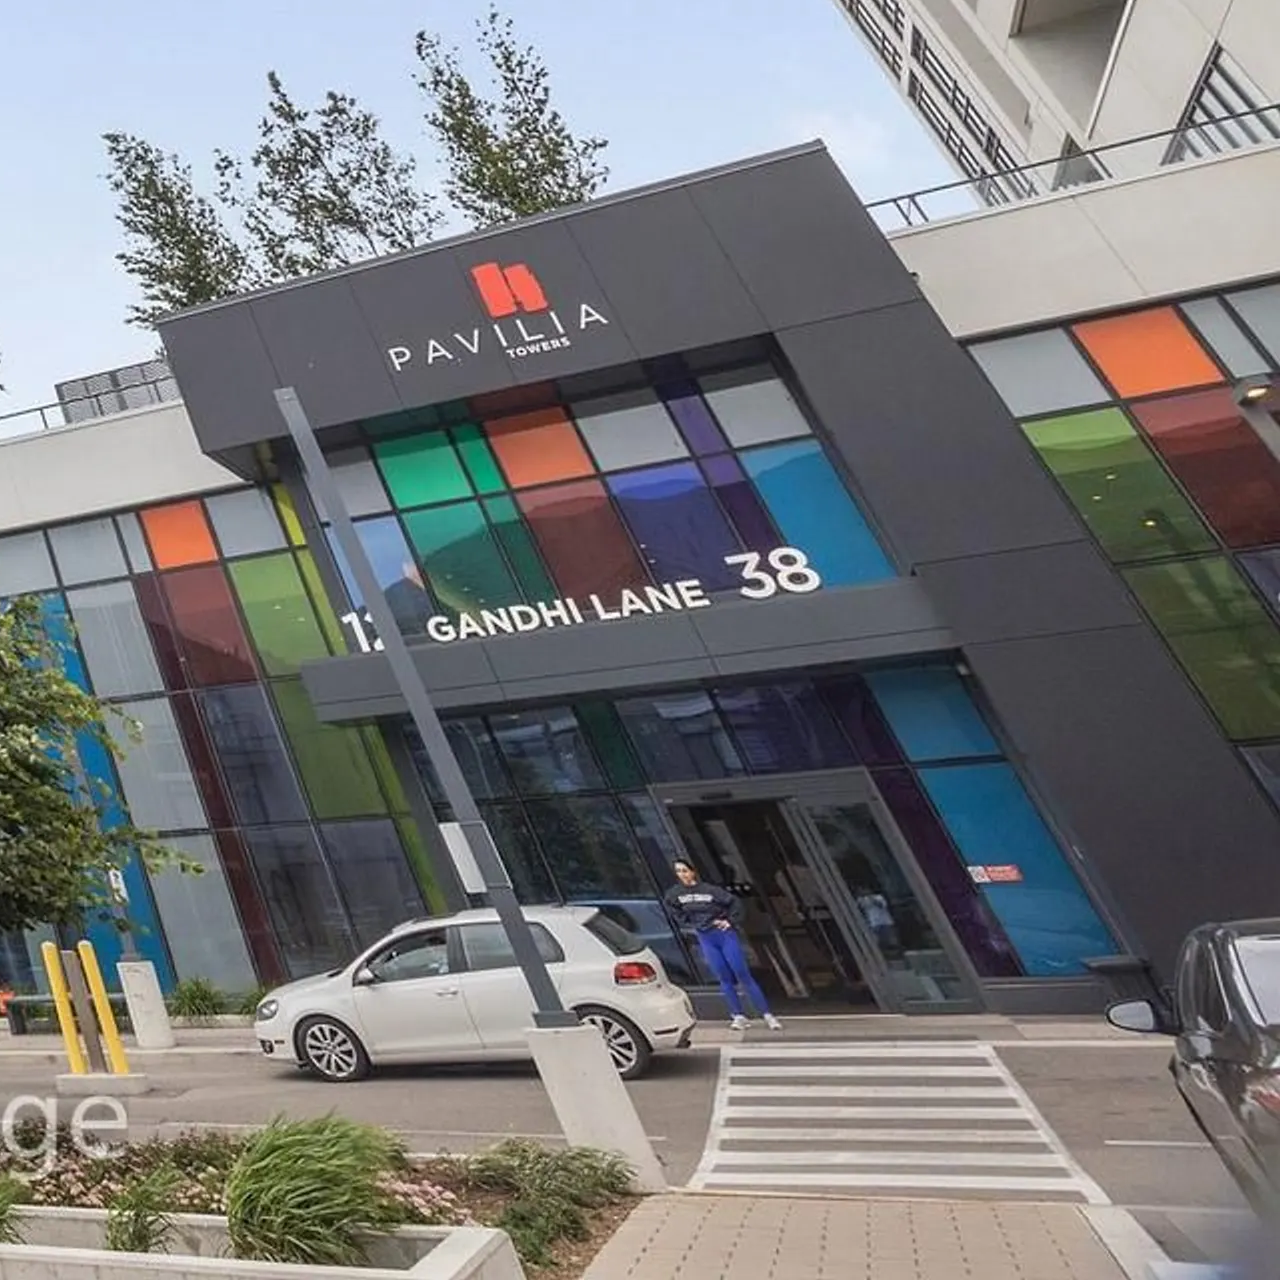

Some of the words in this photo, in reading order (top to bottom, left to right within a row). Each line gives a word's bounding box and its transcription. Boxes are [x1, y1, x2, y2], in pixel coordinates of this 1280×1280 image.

[388, 303, 609, 371] PAVILIA
[506, 337, 571, 358] TOWERS
[426, 597, 583, 642] GANDHI
[590, 579, 711, 621] LANE
[724, 546, 822, 599] 38
